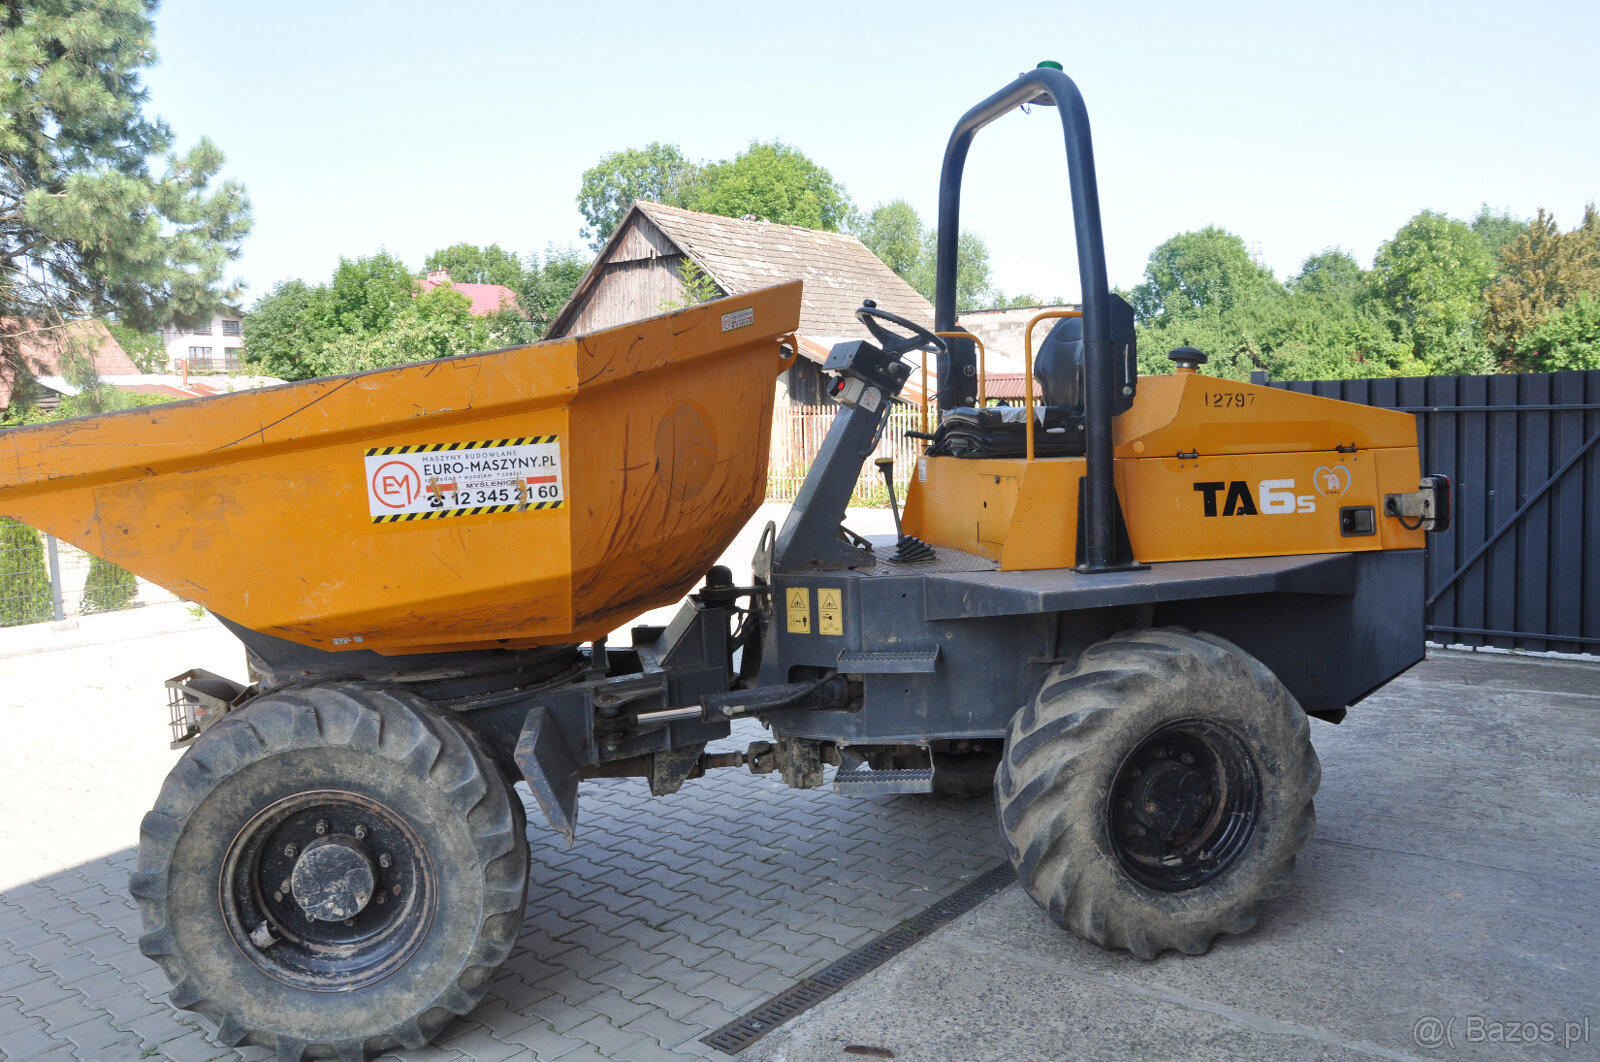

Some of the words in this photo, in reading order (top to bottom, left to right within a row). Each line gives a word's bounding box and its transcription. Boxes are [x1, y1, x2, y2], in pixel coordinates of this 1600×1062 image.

[1204, 392, 1255, 408] 12797
[422, 454, 462, 462] MASZYNY
[464, 449, 518, 460] BUDOWLANE
[423, 455, 557, 476] EURO-MASZYNY.PL
[464, 472, 493, 480] wynajem
[465, 479, 518, 489] MYŚLENICE
[382, 474, 412, 505] EM
[451, 491, 471, 506] 12
[476, 488, 509, 504] 345
[537, 484, 559, 499] 60
